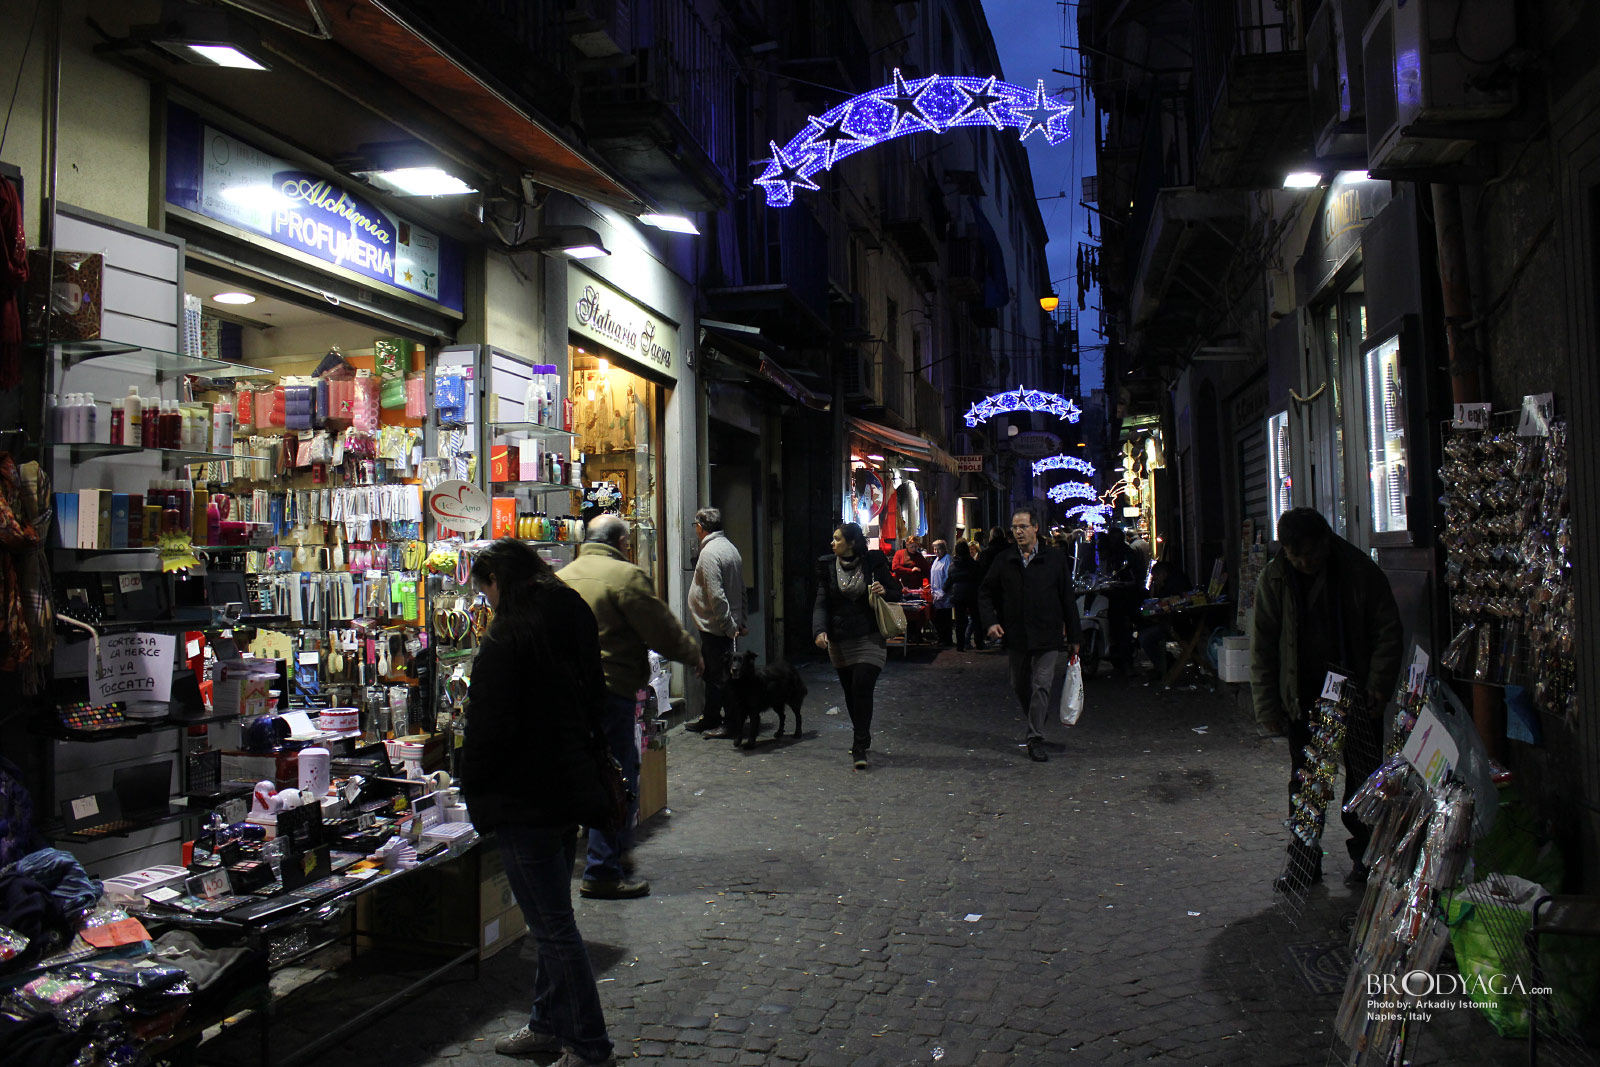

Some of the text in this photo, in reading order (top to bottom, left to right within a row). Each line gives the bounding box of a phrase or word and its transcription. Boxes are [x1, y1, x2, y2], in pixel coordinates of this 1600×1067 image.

[282, 180, 390, 244] Alchimia
[1324, 189, 1361, 242] COMETA
[275, 208, 393, 278] PROFUMERIA
[576, 285, 671, 367] Statuaria Sacra
[108, 637, 157, 648] CORTESIA
[110, 648, 161, 659] LA MERCE
[119, 661, 135, 671] VA
[99, 677, 155, 695] TOCCATA
